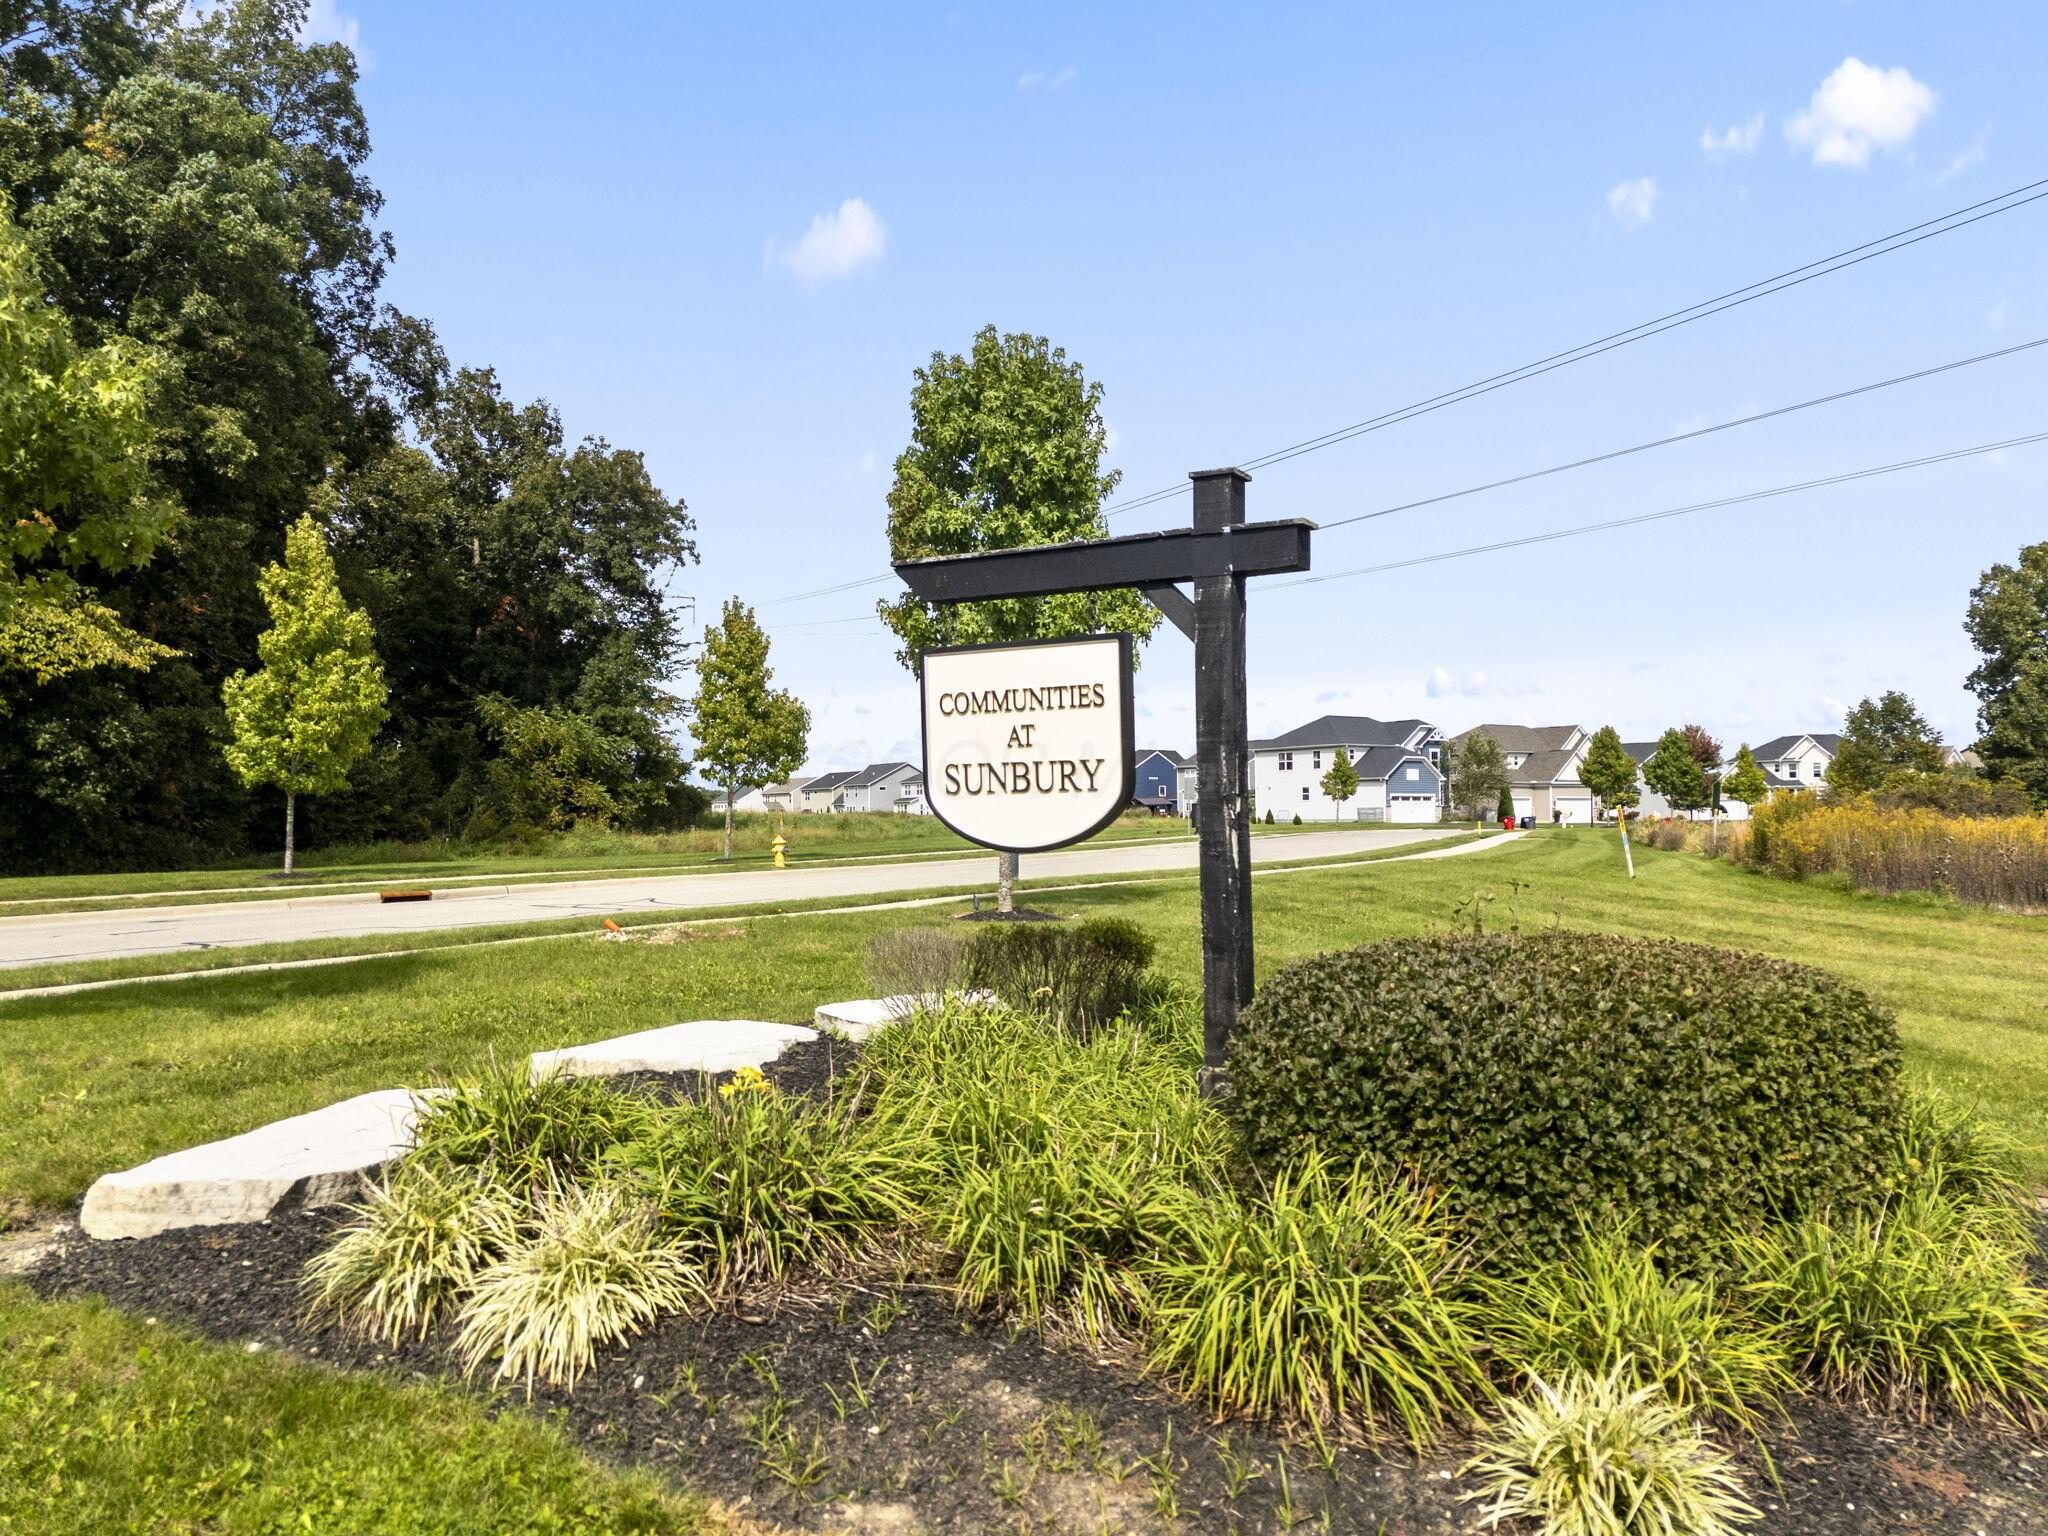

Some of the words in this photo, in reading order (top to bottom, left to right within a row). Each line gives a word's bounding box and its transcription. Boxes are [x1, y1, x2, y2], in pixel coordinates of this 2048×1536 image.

[939, 683, 1105, 716] COMMUNITIES
[1007, 724, 1036, 749] AT
[944, 758, 1105, 797] SUNBURY
